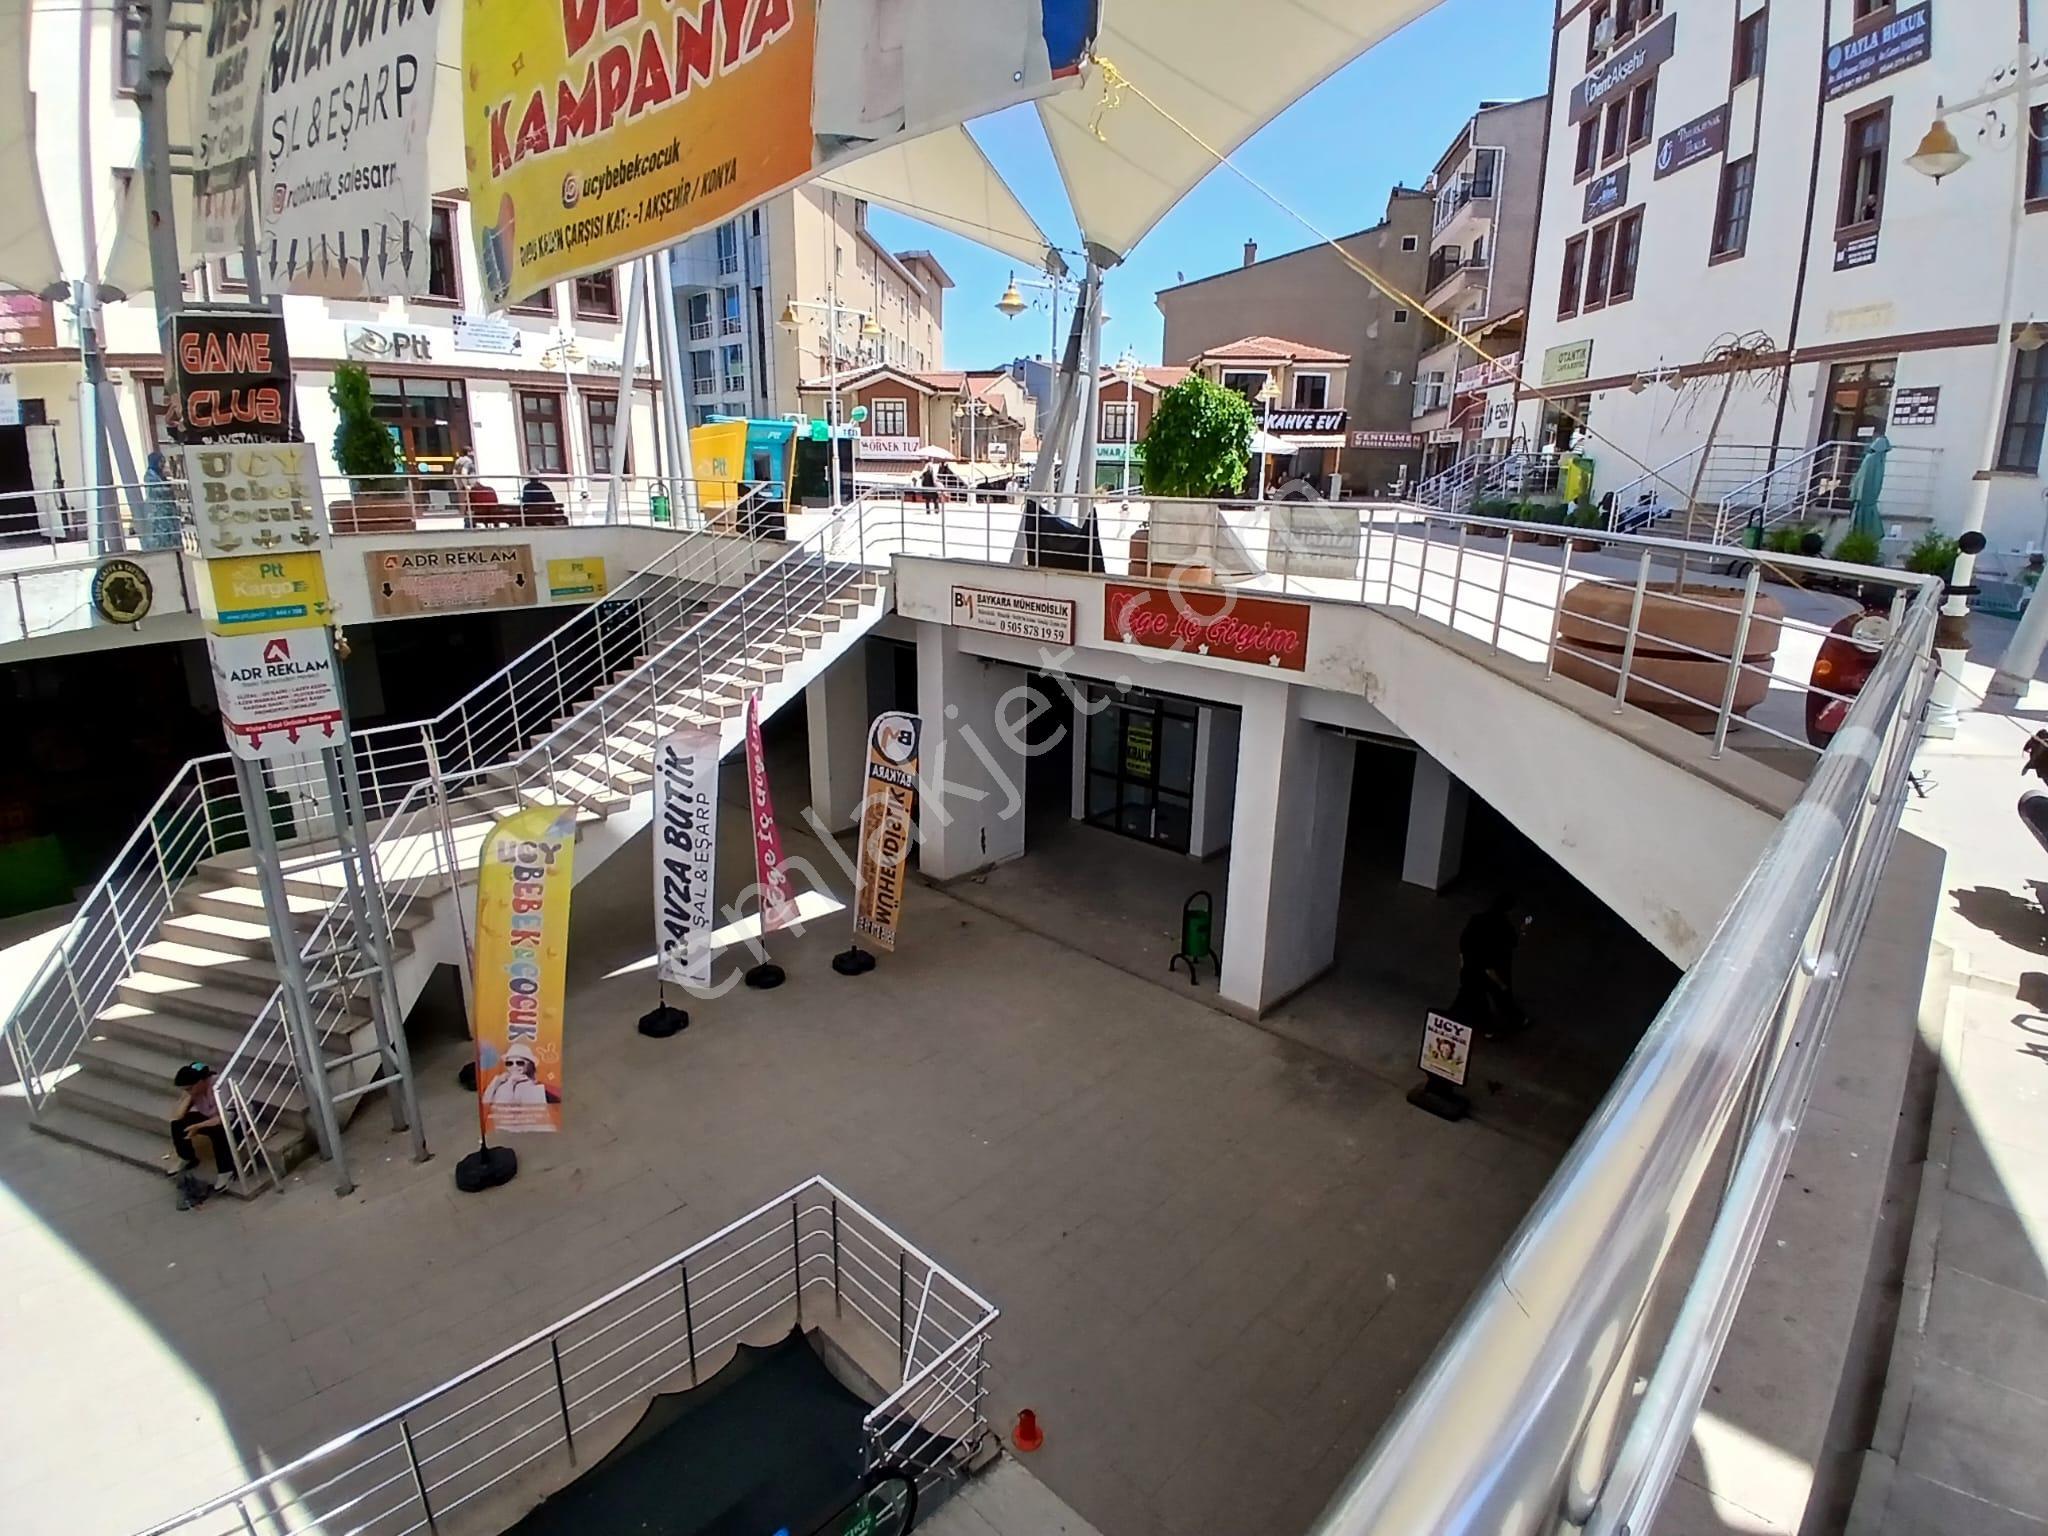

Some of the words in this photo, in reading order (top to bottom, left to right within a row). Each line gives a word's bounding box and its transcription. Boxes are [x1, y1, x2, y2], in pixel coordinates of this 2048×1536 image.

[307, 96, 321, 149] &
[327, 54, 418, 151] EŞARP
[490, 0, 791, 178] KAMPANYA
[583, 137, 682, 199] ucybebekcocuk
[565, 214, 604, 253] ÇARŞISI
[644, 177, 691, 224] AKŞEHİR
[701, 158, 737, 196] KONYA
[179, 332, 273, 375] GAME
[394, 331, 433, 360] Ptt
[187, 388, 282, 428] CLUB
[1268, 413, 1313, 430] KAHVE
[1315, 411, 1343, 430] EVİ
[712, 458, 727, 476] Ptt
[259, 563, 285, 578] Ptt
[402, 555, 439, 568] ADR
[445, 551, 517, 565] REKLAM
[977, 593, 1011, 607] BAYKARA
[1013, 599, 1069, 617] MÜHENDİSLİK
[1000, 620, 1006, 630] 0
[1007, 621, 1021, 633] 505
[1023, 624, 1040, 637] 878
[1042, 627, 1052, 639] 19
[1054, 630, 1064, 640] 59
[1206, 615, 1299, 653] Giyim
[231, 667, 262, 682] ADR
[267, 658, 329, 678] REKLAM
[656, 745, 694, 853] BUTİK
[694, 792, 713, 863] EŞARP
[694, 869, 708, 882] &
[510, 864, 545, 946] BEBEK
[693, 888, 710, 929] ŞAL
[503, 962, 539, 1041] ÇOCUK
